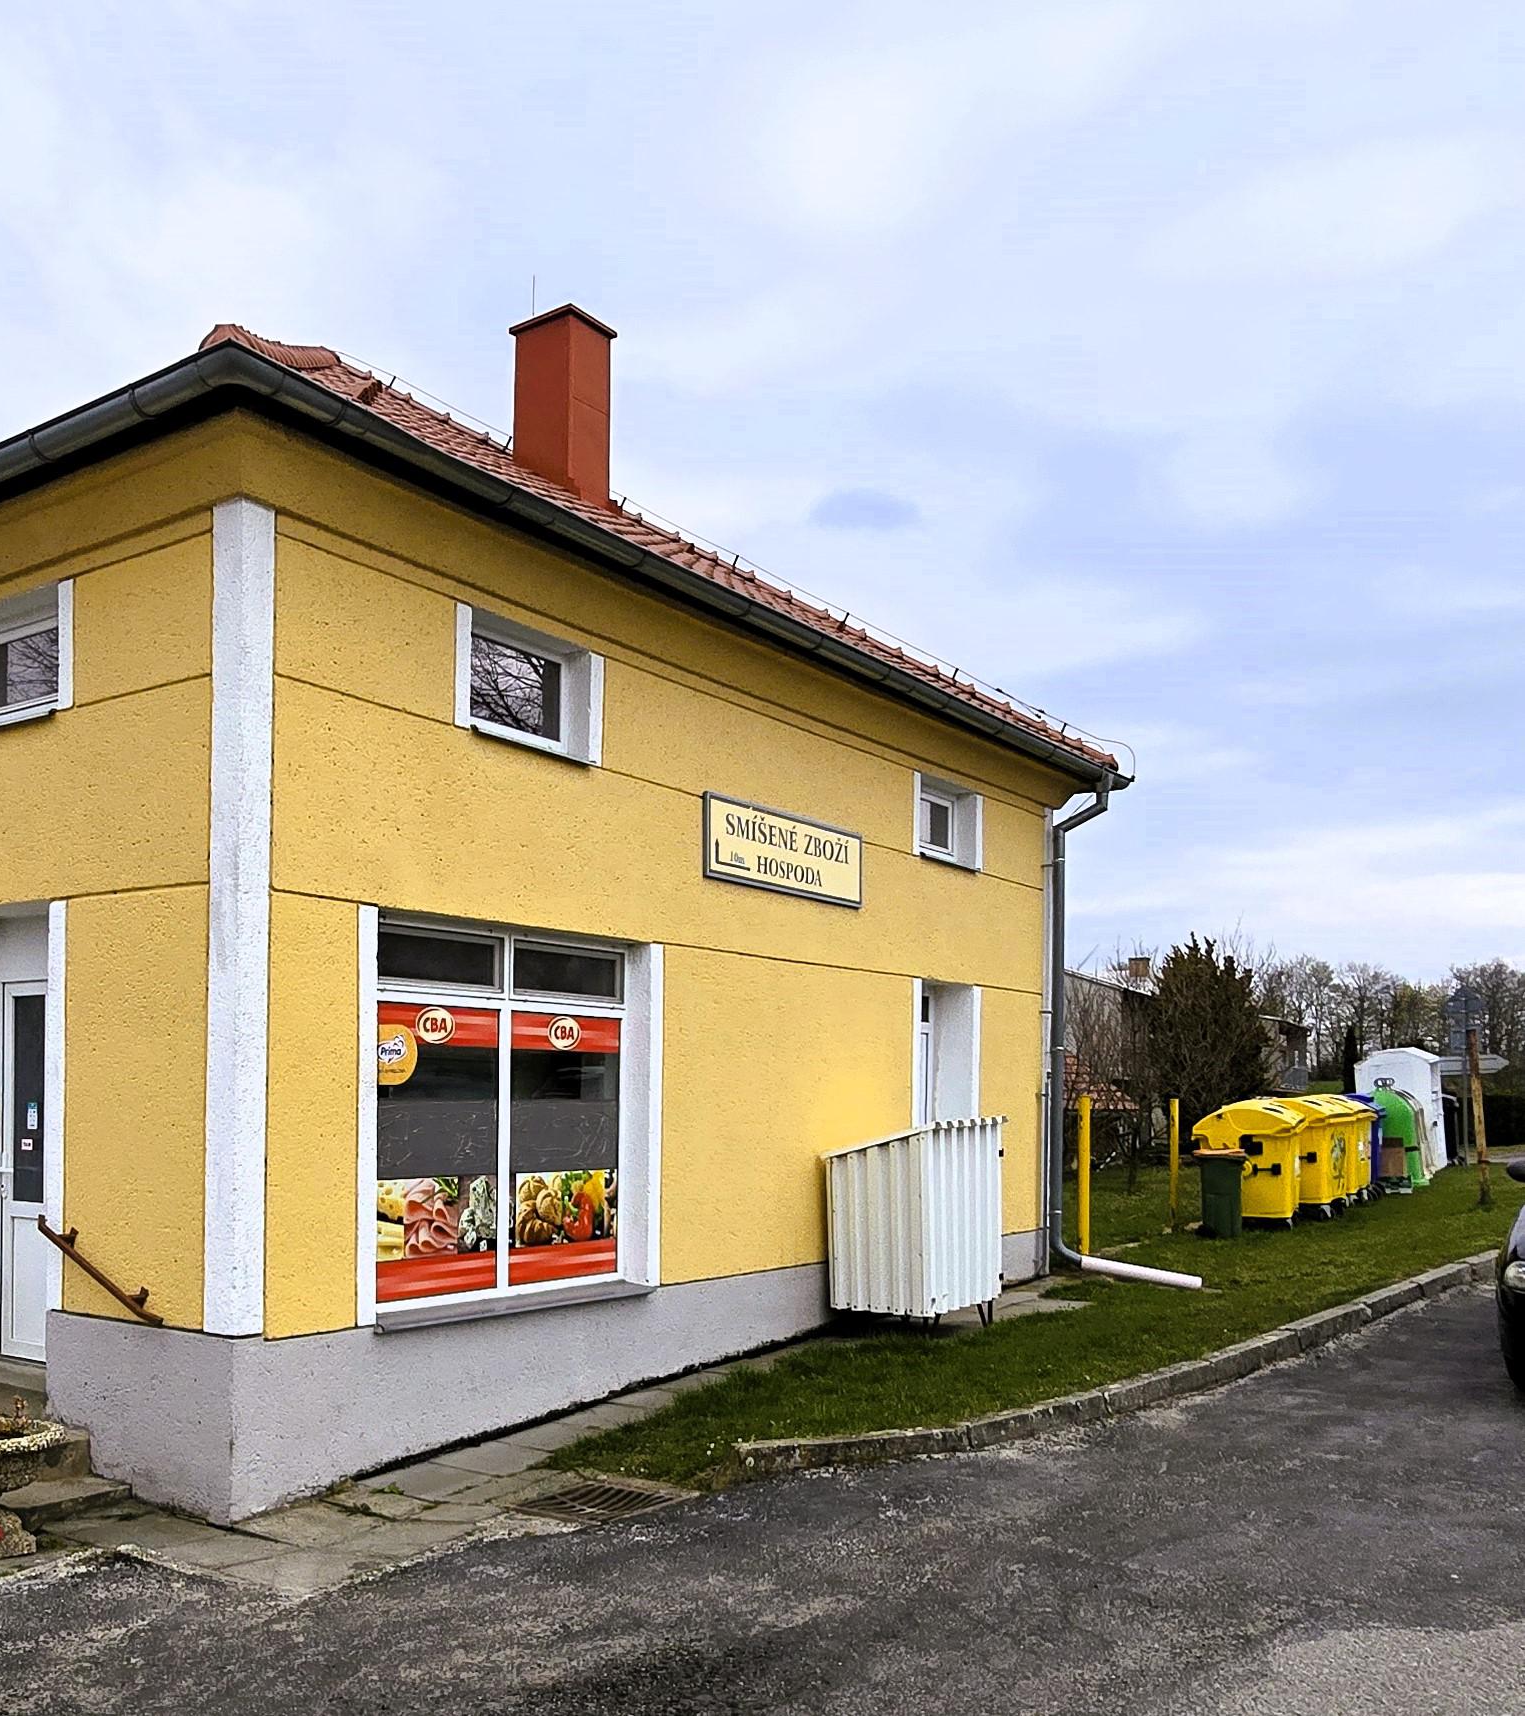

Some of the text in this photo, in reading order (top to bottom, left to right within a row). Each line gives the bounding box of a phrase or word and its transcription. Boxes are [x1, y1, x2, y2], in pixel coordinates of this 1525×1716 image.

[725, 813, 850, 864] SMÍŠENÉ ZBOŽÍ
[730, 850, 745, 864] 10m
[757, 856, 822, 887] HOSPODA
[422, 1016, 448, 1033] CBA
[554, 1025, 575, 1041] CBA
[380, 1046, 402, 1056] Prima
